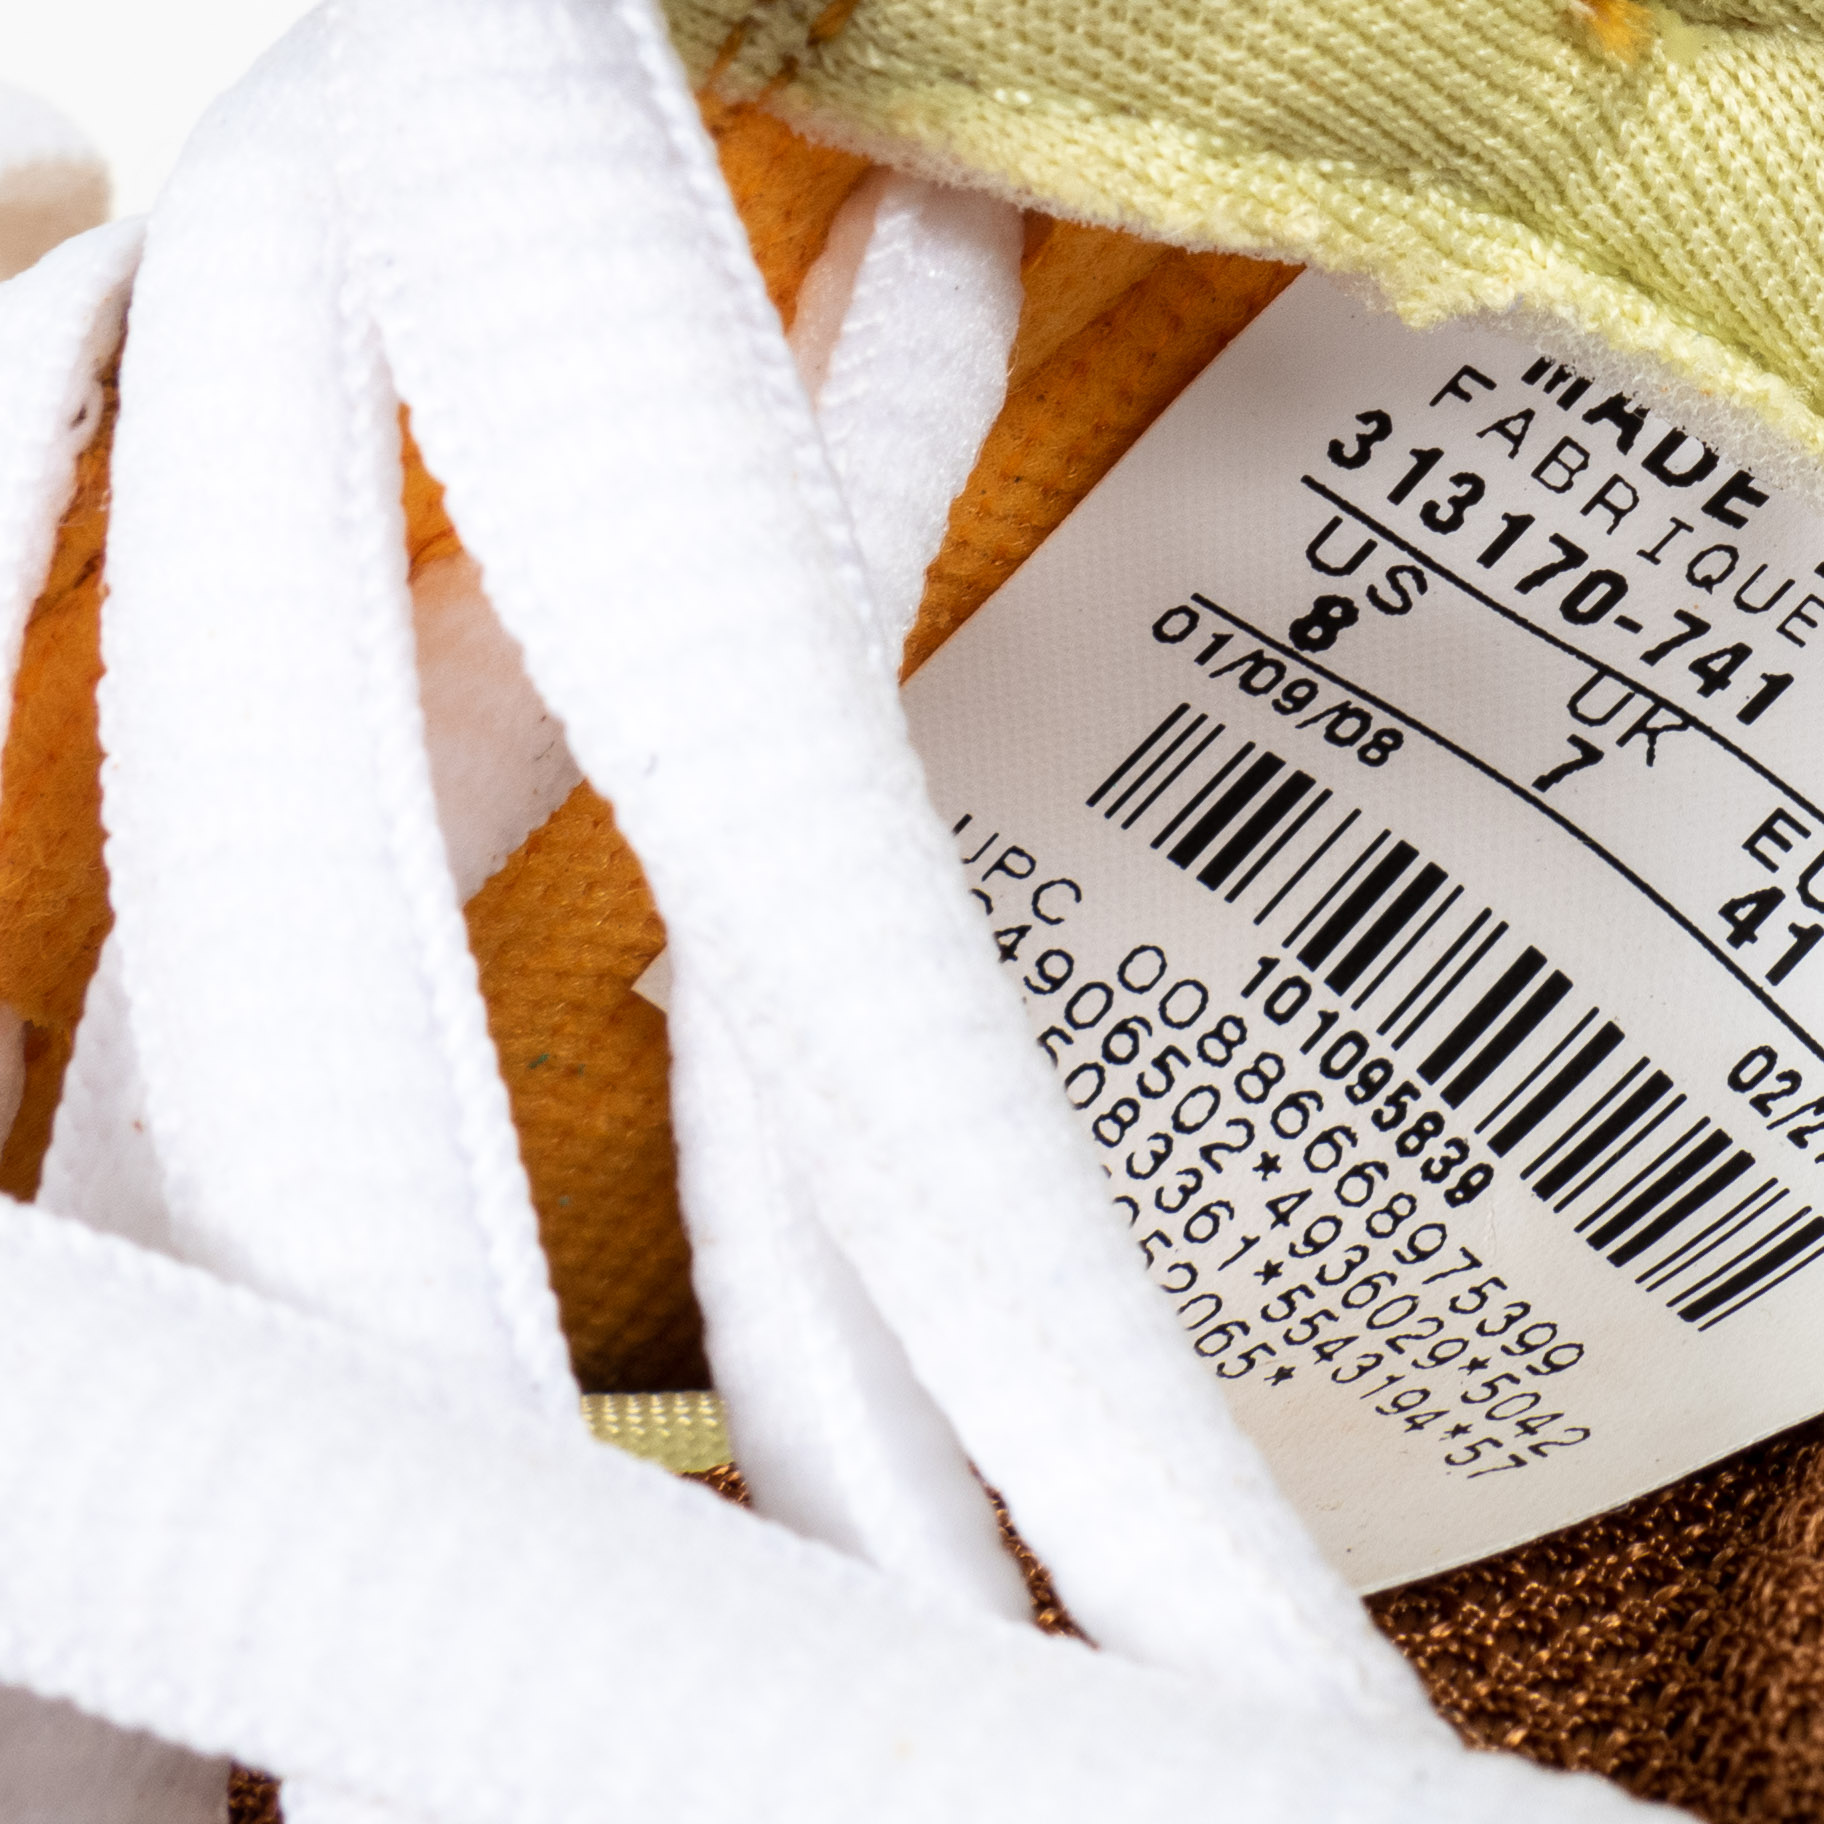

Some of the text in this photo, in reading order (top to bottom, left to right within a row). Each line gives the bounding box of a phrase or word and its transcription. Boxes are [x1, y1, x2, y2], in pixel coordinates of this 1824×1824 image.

[1327, 409, 1794, 725] 313170-741
[1521, 356, 1769, 529] MADE
[1152, 605, 1404, 767] 01/09/08
[1306, 515, 1428, 616] US
[1567, 669, 1692, 766] UK
[1289, 594, 1359, 653] 8
[1532, 734, 1604, 792] 7
[1718, 886, 1824, 986] 41
[970, 888, 1591, 1457] 490650249360295042
[1118, 945, 1585, 1376] 00886668975399
[1241, 956, 1494, 1208] 101095839
